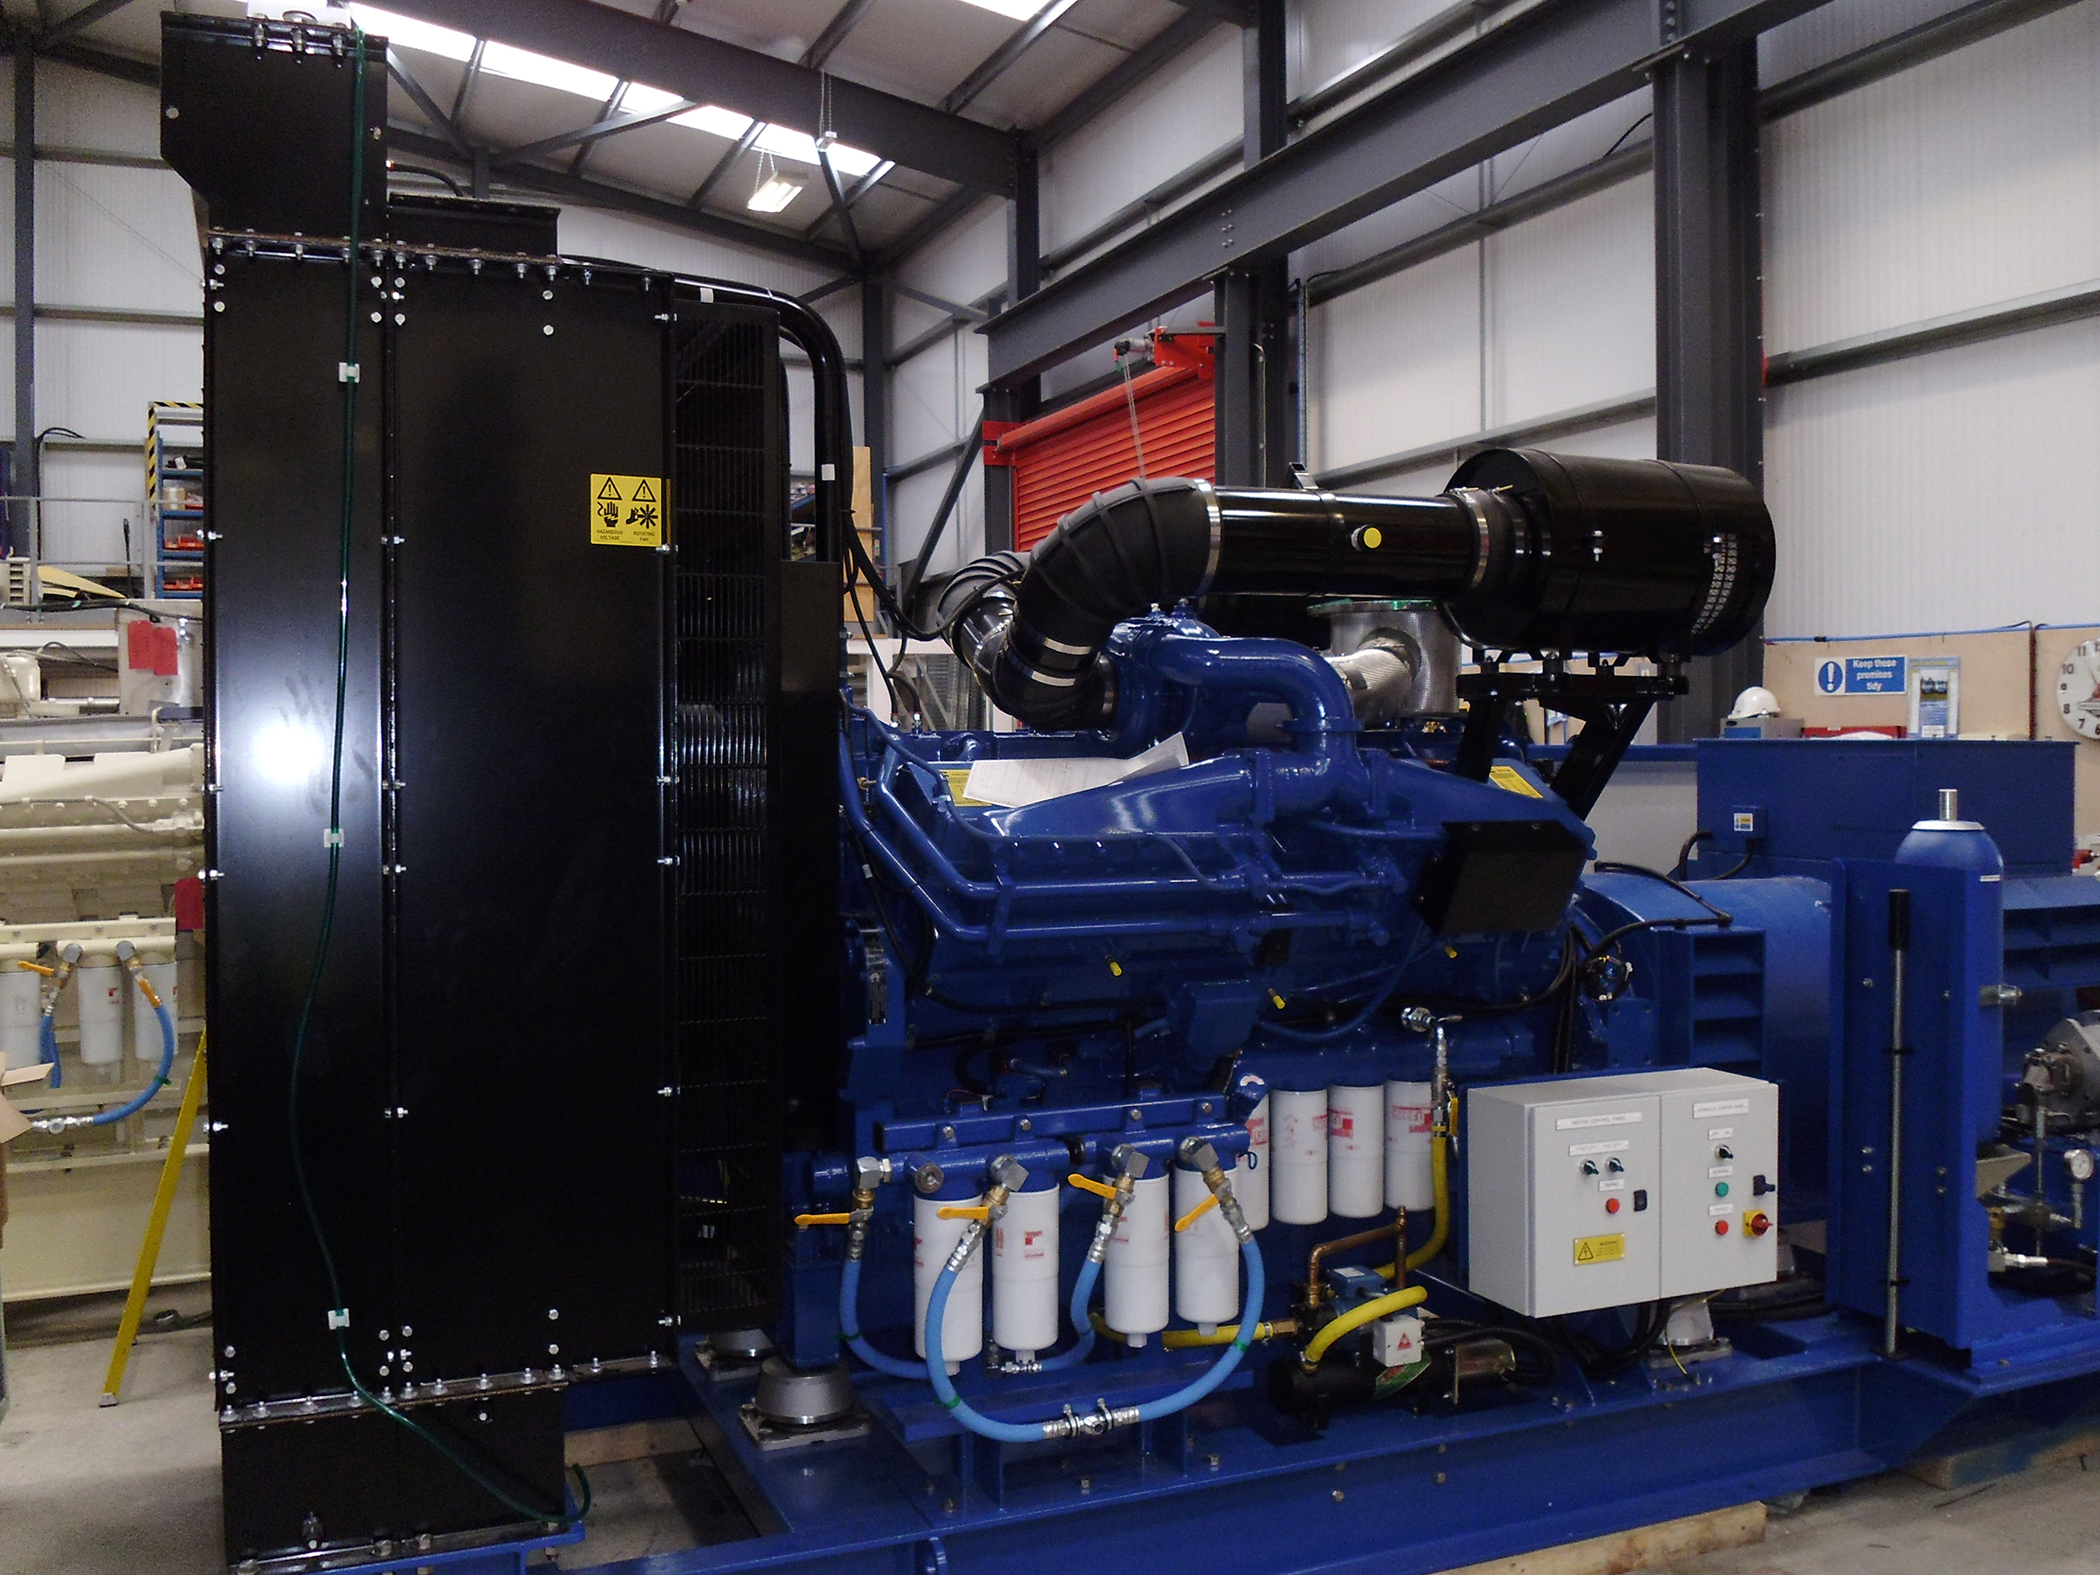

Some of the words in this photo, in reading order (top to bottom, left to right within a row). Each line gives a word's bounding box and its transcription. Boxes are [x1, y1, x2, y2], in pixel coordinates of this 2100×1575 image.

[2077, 646, 2086, 657] 11
[1853, 659, 1874, 669] Keep
[1875, 658, 1896, 667] these
[2062, 663, 2075, 675] 10
[1856, 671, 1893, 681] premises
[1866, 682, 1882, 691] tidy
[2063, 703, 2070, 714] 8
[2078, 718, 2086, 729] 7
